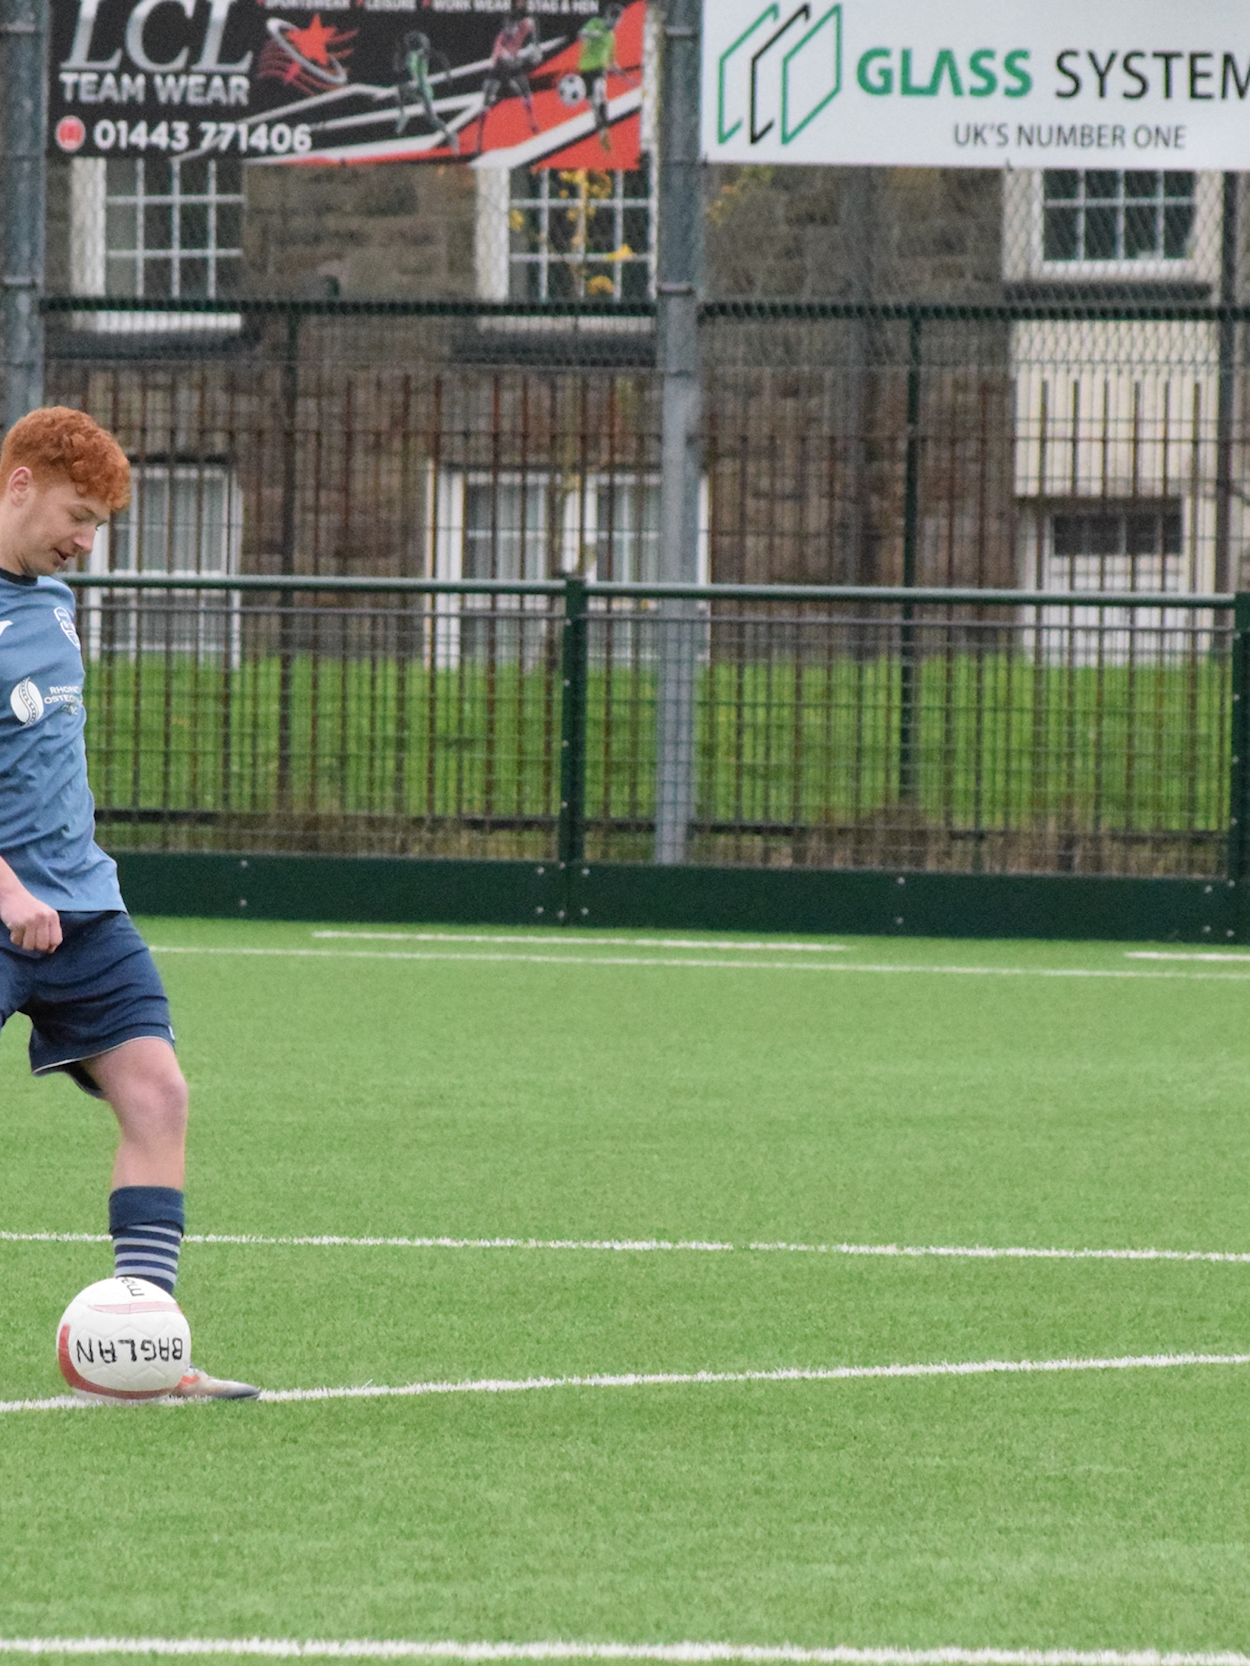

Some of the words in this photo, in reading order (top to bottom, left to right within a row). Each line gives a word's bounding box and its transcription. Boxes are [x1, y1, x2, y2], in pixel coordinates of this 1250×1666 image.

[59, 0, 252, 73] LCL
[856, 47, 1034, 98] GLASS
[59, 73, 147, 104] TEAM
[150, 74, 251, 106] WEAR
[93, 119, 190, 149] 01443
[197, 121, 312, 152] 771406
[953, 122, 1010, 147] UK'S
[1016, 122, 1126, 149] NUMBER
[1132, 124, 1186, 150] ONE
[76, 1337, 183, 1364] BAGLAN
